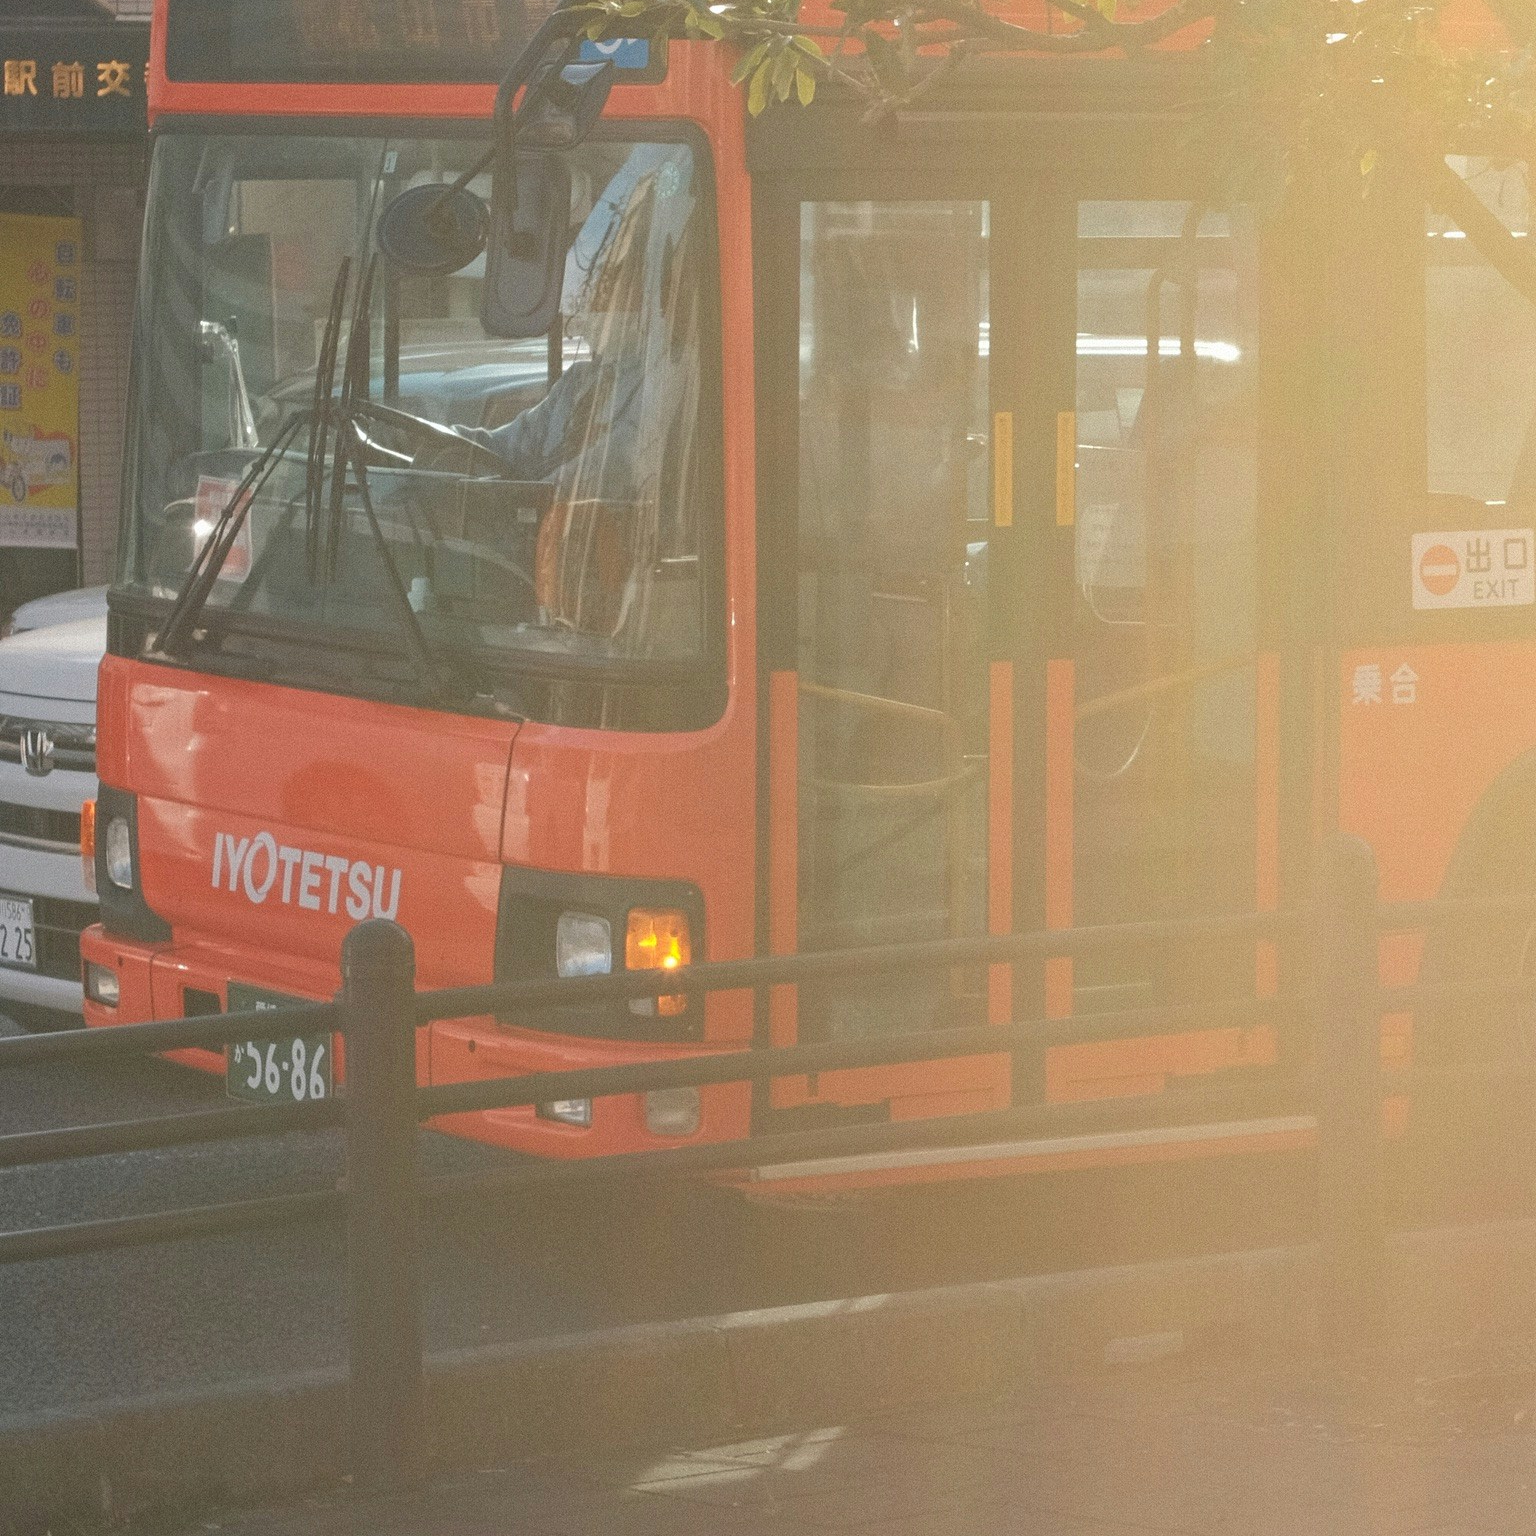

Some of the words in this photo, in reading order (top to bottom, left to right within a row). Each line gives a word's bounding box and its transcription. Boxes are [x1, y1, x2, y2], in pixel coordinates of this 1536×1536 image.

[4, 59, 149, 99] 駅前交
[1465, 537, 1528, 574] 出口
[1473, 578, 1519, 601] EXIT
[1352, 663, 1419, 705] 乗合
[212, 830, 403, 922] IYOTETSU
